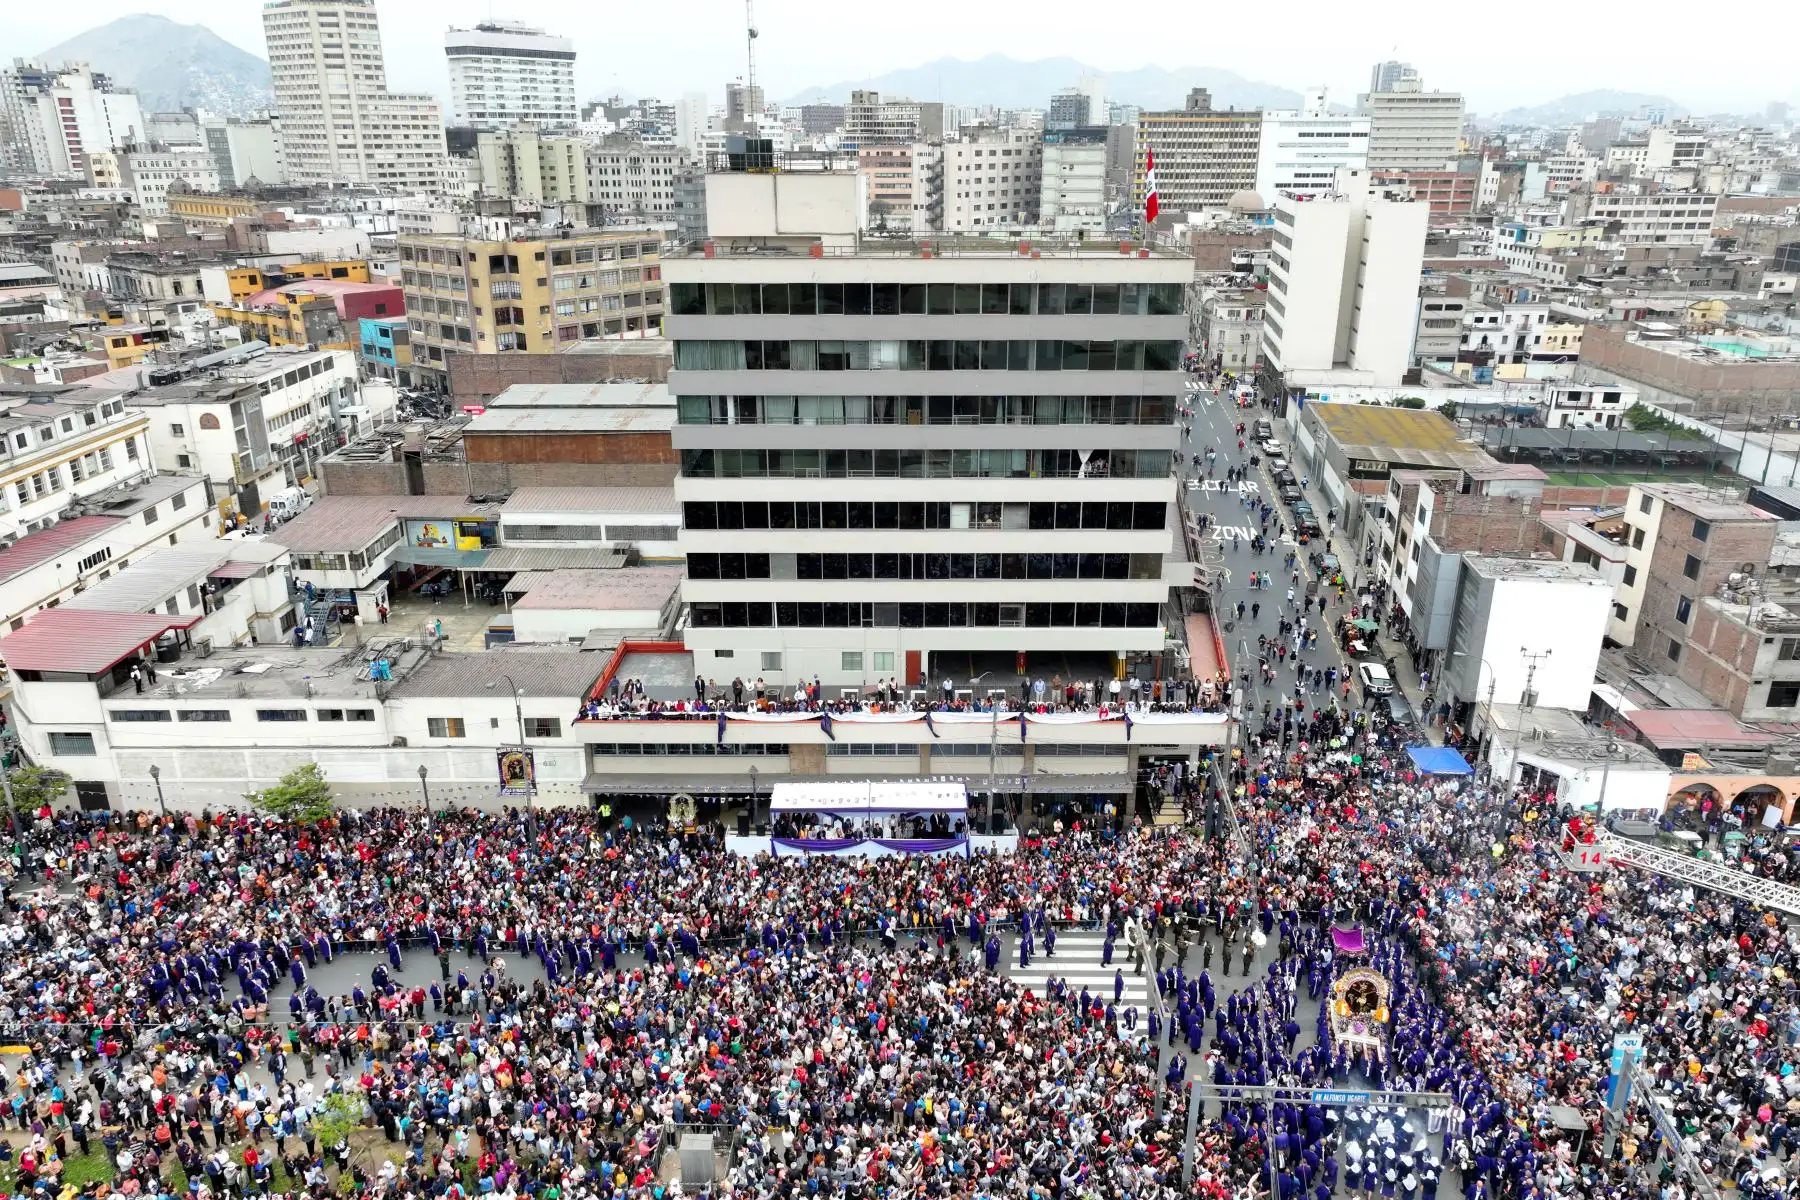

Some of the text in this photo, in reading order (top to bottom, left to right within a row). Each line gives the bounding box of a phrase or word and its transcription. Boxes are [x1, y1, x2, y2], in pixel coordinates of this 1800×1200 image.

[1356, 461, 1386, 470] PLAYA
[1187, 479, 1260, 493] ESCOLAR
[1212, 526, 1258, 541] ZONA
[1580, 851, 1600, 865] 14
[1323, 1093, 1346, 1102] ALFONSO
